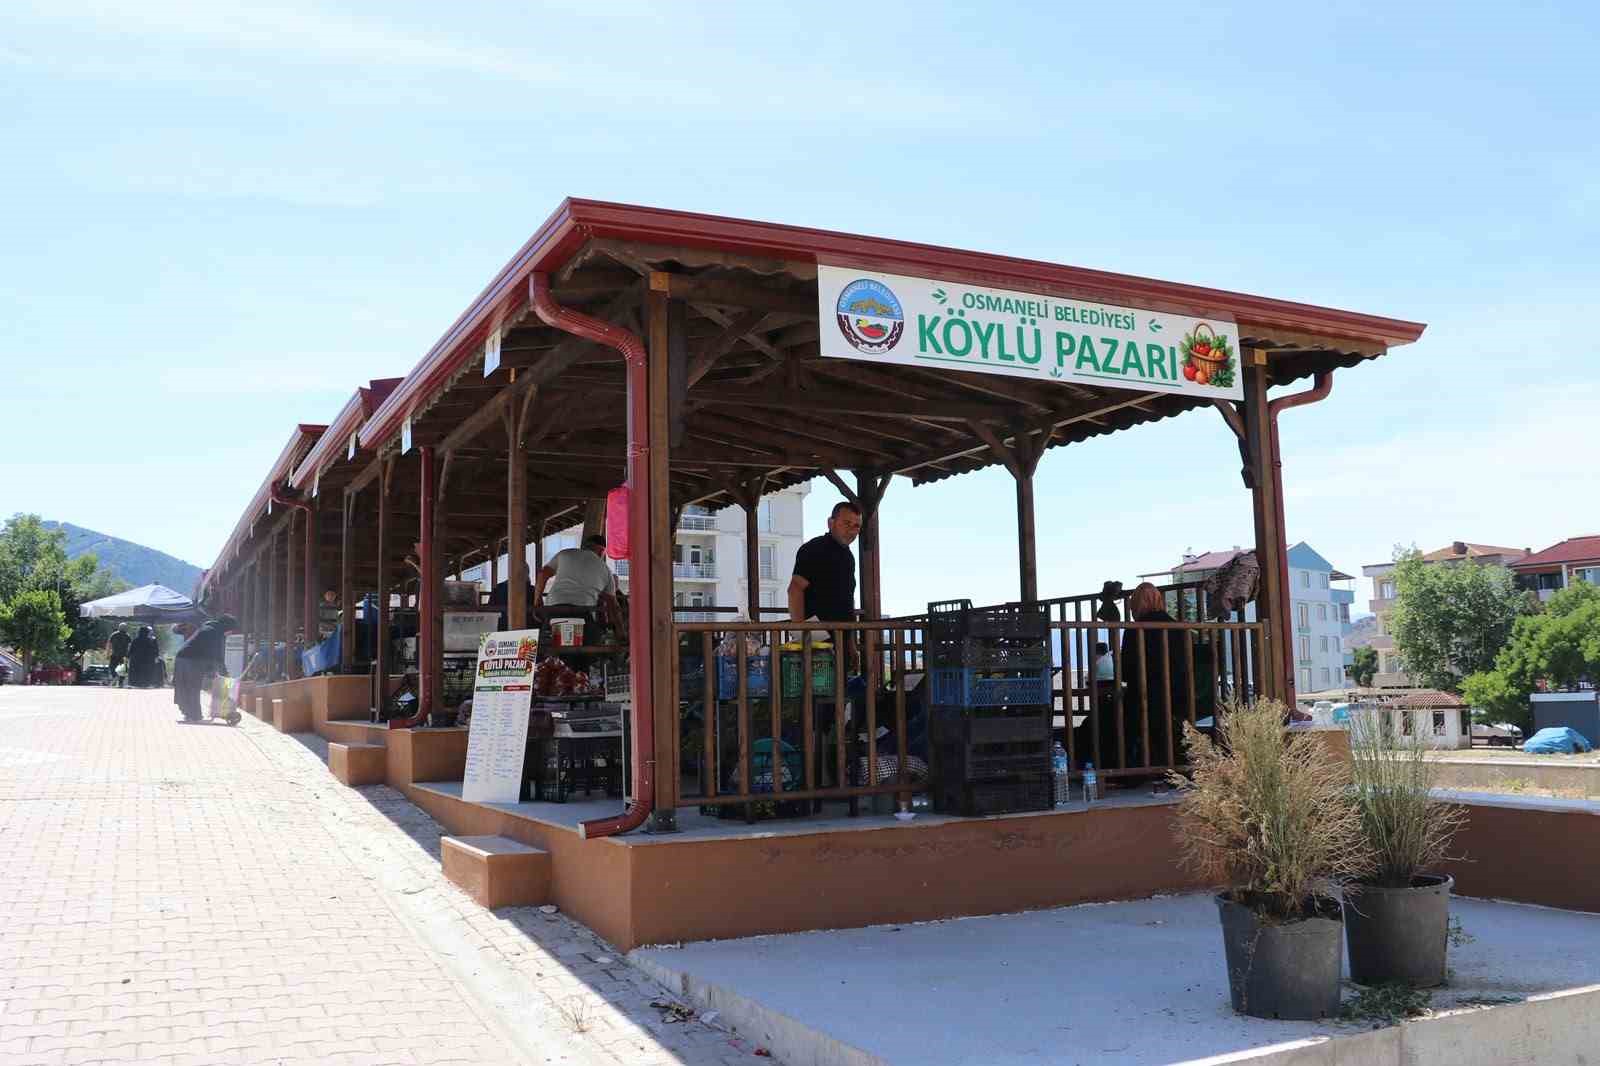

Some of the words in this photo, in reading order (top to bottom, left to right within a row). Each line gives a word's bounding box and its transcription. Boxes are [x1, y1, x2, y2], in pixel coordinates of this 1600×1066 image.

[962, 292, 1048, 319] OSMANELİ
[1055, 305, 1136, 331] BELEDİYESİ
[917, 307, 1042, 364] KÖYLÜ
[1055, 331, 1179, 380] PAZARI
